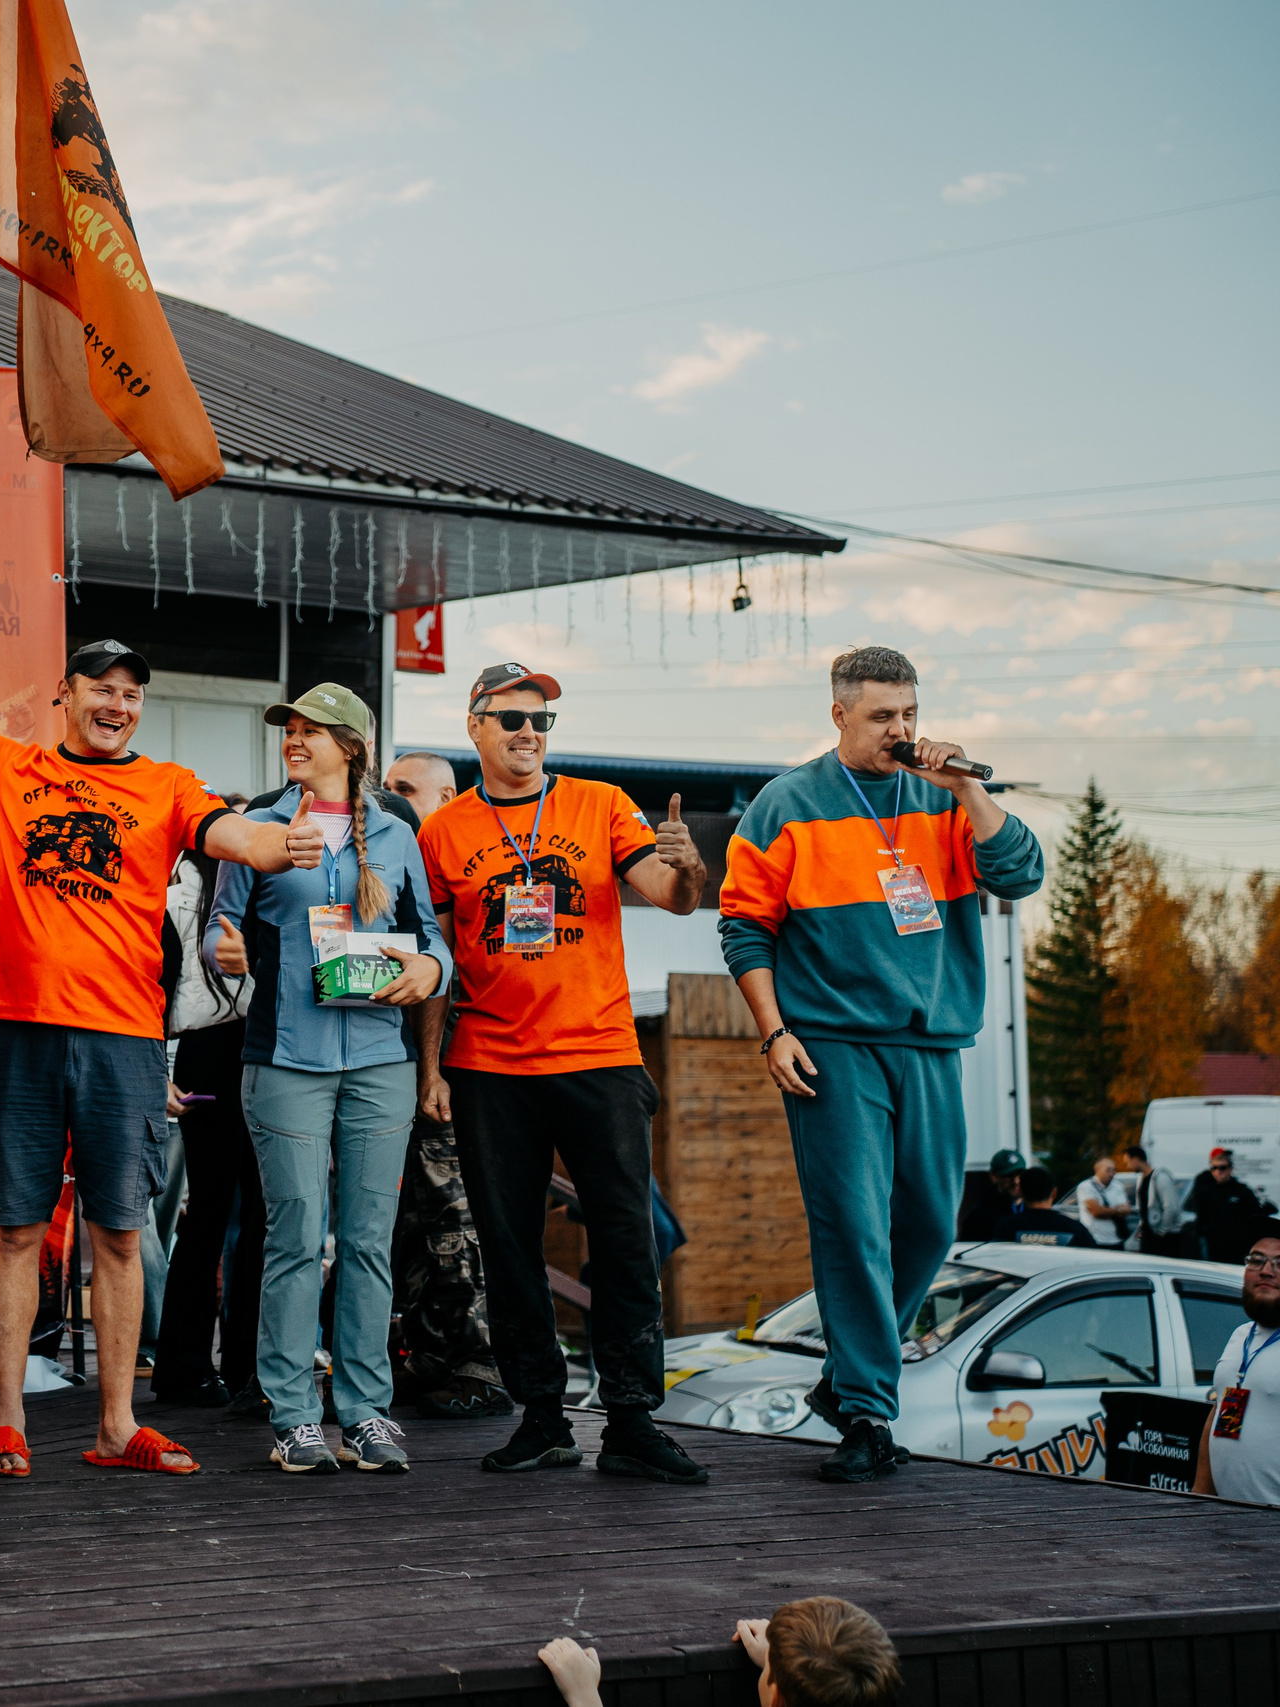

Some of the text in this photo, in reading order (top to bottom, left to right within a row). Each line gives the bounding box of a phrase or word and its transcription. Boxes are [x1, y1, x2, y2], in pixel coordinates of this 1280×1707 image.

[548, 834, 587, 862] CLUB
[486, 926, 584, 956] ПРТОР
[1144, 1429, 1163, 1444] ГОРА
[1143, 1442, 1190, 1461] СОБОЛИНАЯ
